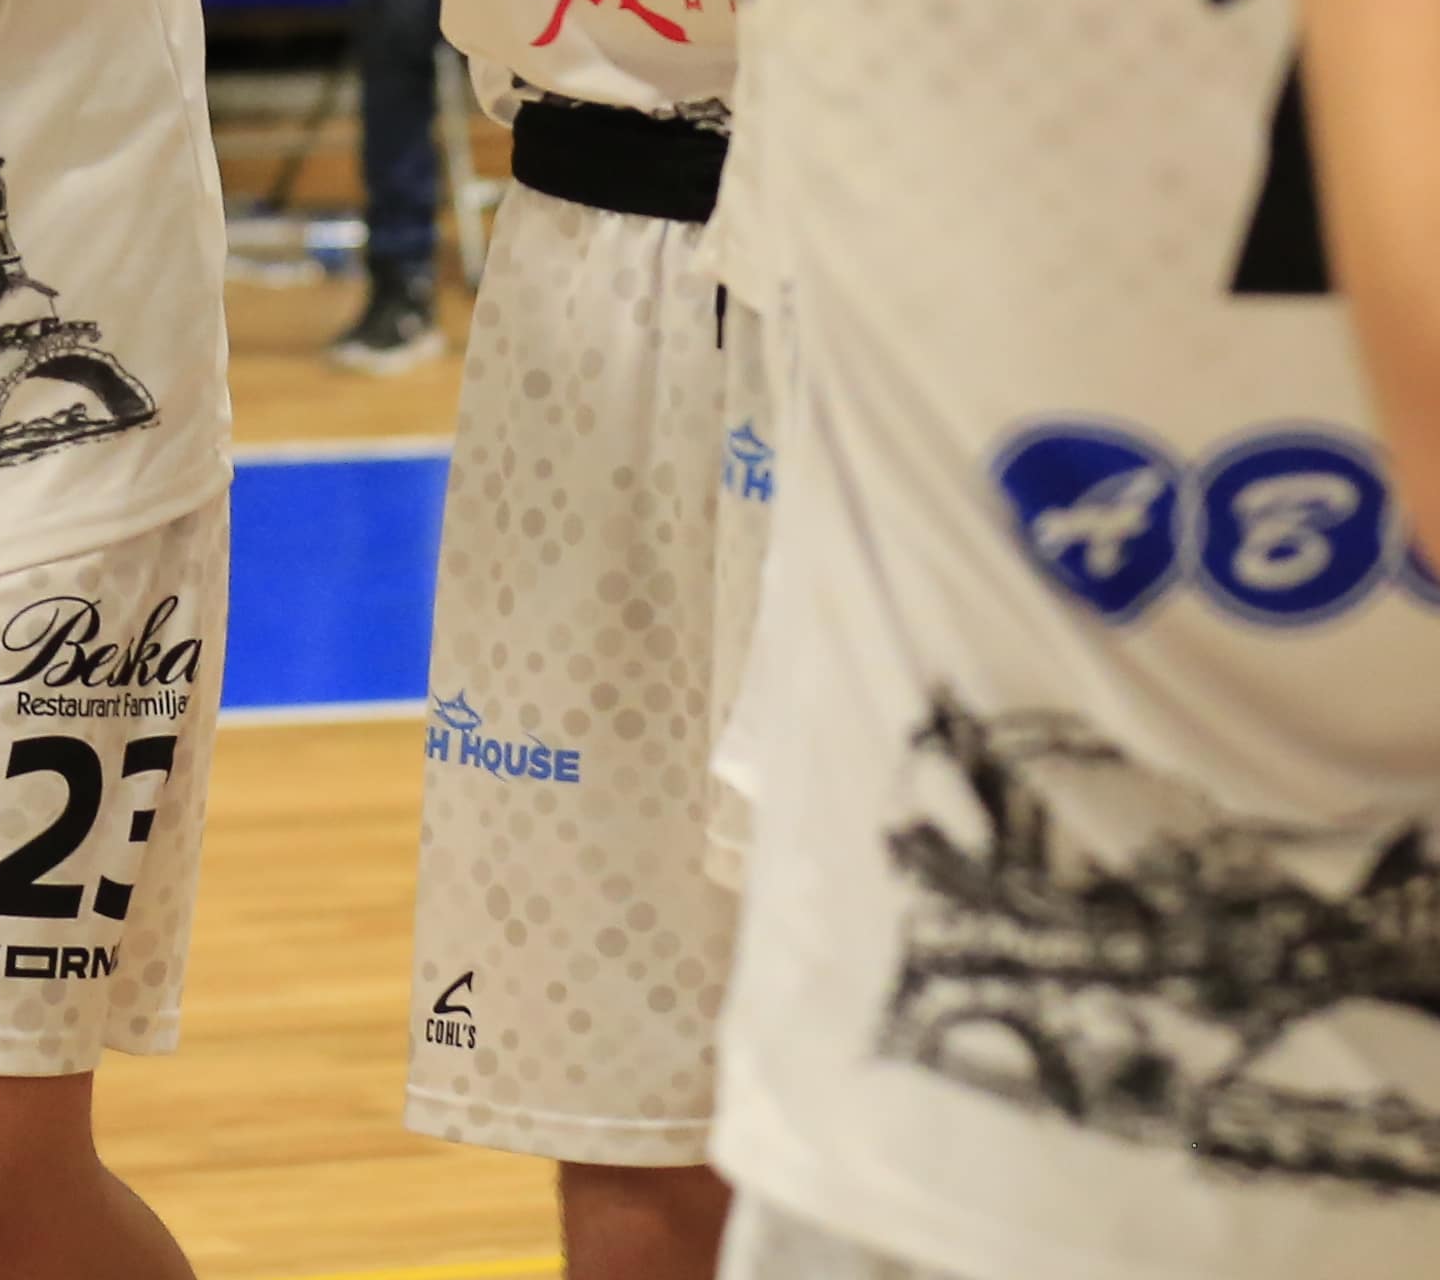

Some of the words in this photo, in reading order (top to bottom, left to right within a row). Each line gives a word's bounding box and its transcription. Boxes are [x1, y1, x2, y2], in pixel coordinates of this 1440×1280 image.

[16, 691, 121, 718] Restaurant
[459, 728, 581, 784] HOUSE
[425, 1018, 477, 1050] COHL'S
